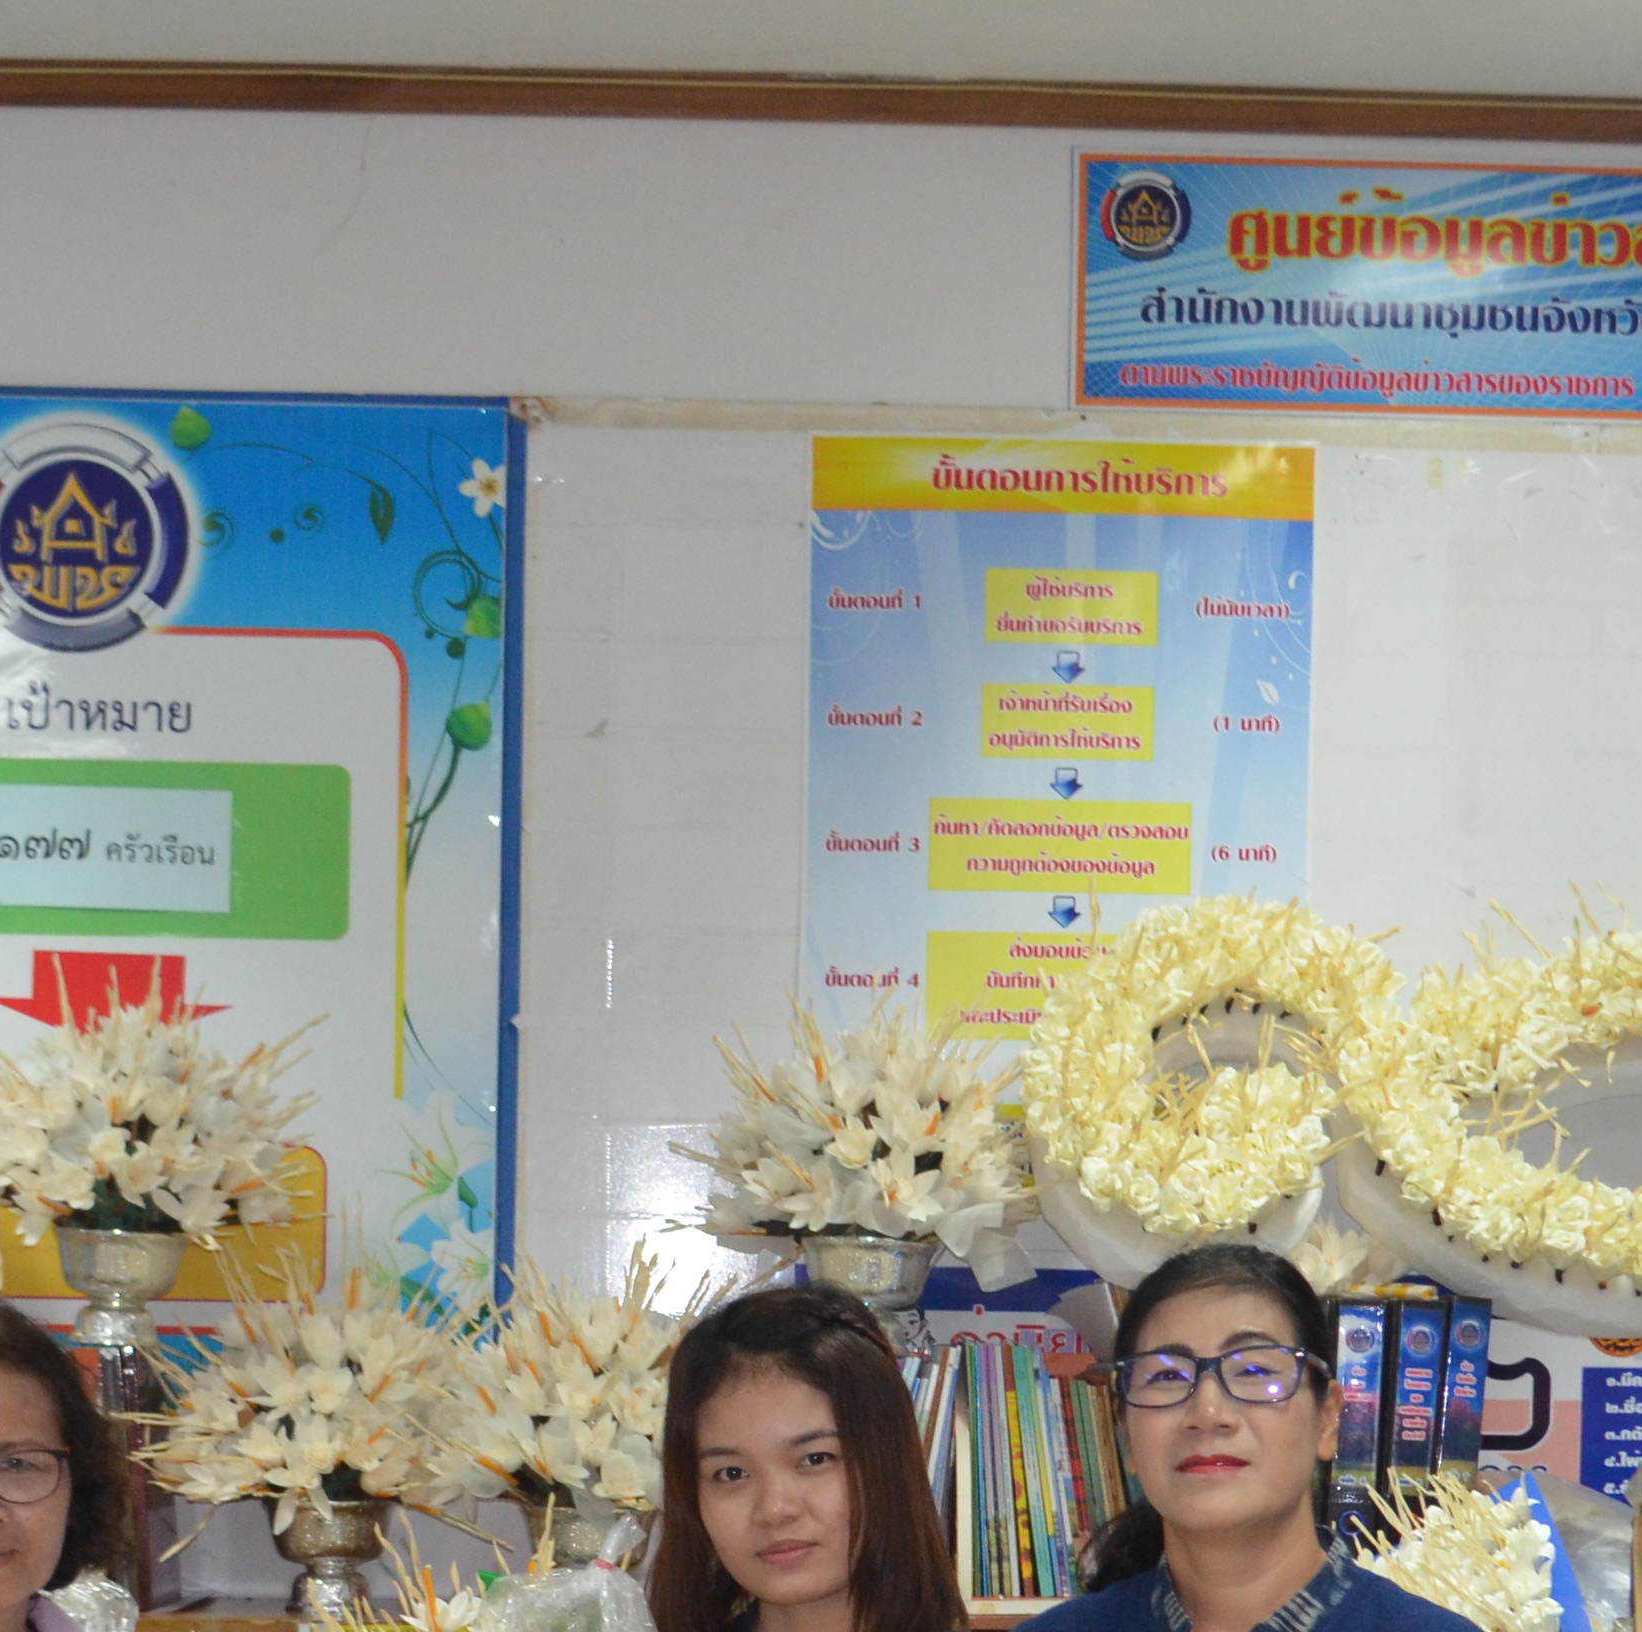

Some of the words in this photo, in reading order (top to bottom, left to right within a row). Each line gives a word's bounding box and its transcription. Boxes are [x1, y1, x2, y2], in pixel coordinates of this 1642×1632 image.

[1119, 358, 1634, 399] ตามพระราชบัญญัติข้อมูลข่าวสารของราชการ
[932, 453, 1229, 498] ขั้นตอนการให้บริการ
[828, 586, 904, 610] ขั้นตอนที่
[912, 592, 922, 610] 1
[1025, 575, 1115, 601] ผู้ใช้บริการ
[1195, 596, 1292, 621] (ไม่นับเวลา)
[995, 611, 1143, 636] ยื่นคำขอรับบริการ
[7, 682, 191, 733] เป้าหมาย
[998, 689, 1134, 714] เจ้าหน้าที่รับเรื่อง
[827, 704, 903, 727] ขั้นตอนที่
[911, 711, 923, 727] 2
[1213, 715, 1231, 733] (1
[1240, 714, 1281, 735] นาที)
[989, 726, 1142, 750] อนุมัติการให้บริการ
[105, 830, 215, 867] ครัวเรือน
[825, 832, 900, 853] ขั้นตอนที่
[909, 836, 921, 853] 3
[1211, 844, 1231, 865] (6
[1238, 843, 1279, 865] นาที)
[966, 851, 1157, 879] ความถูกต้องของข้อมูล
[906, 972, 919, 988] 4
